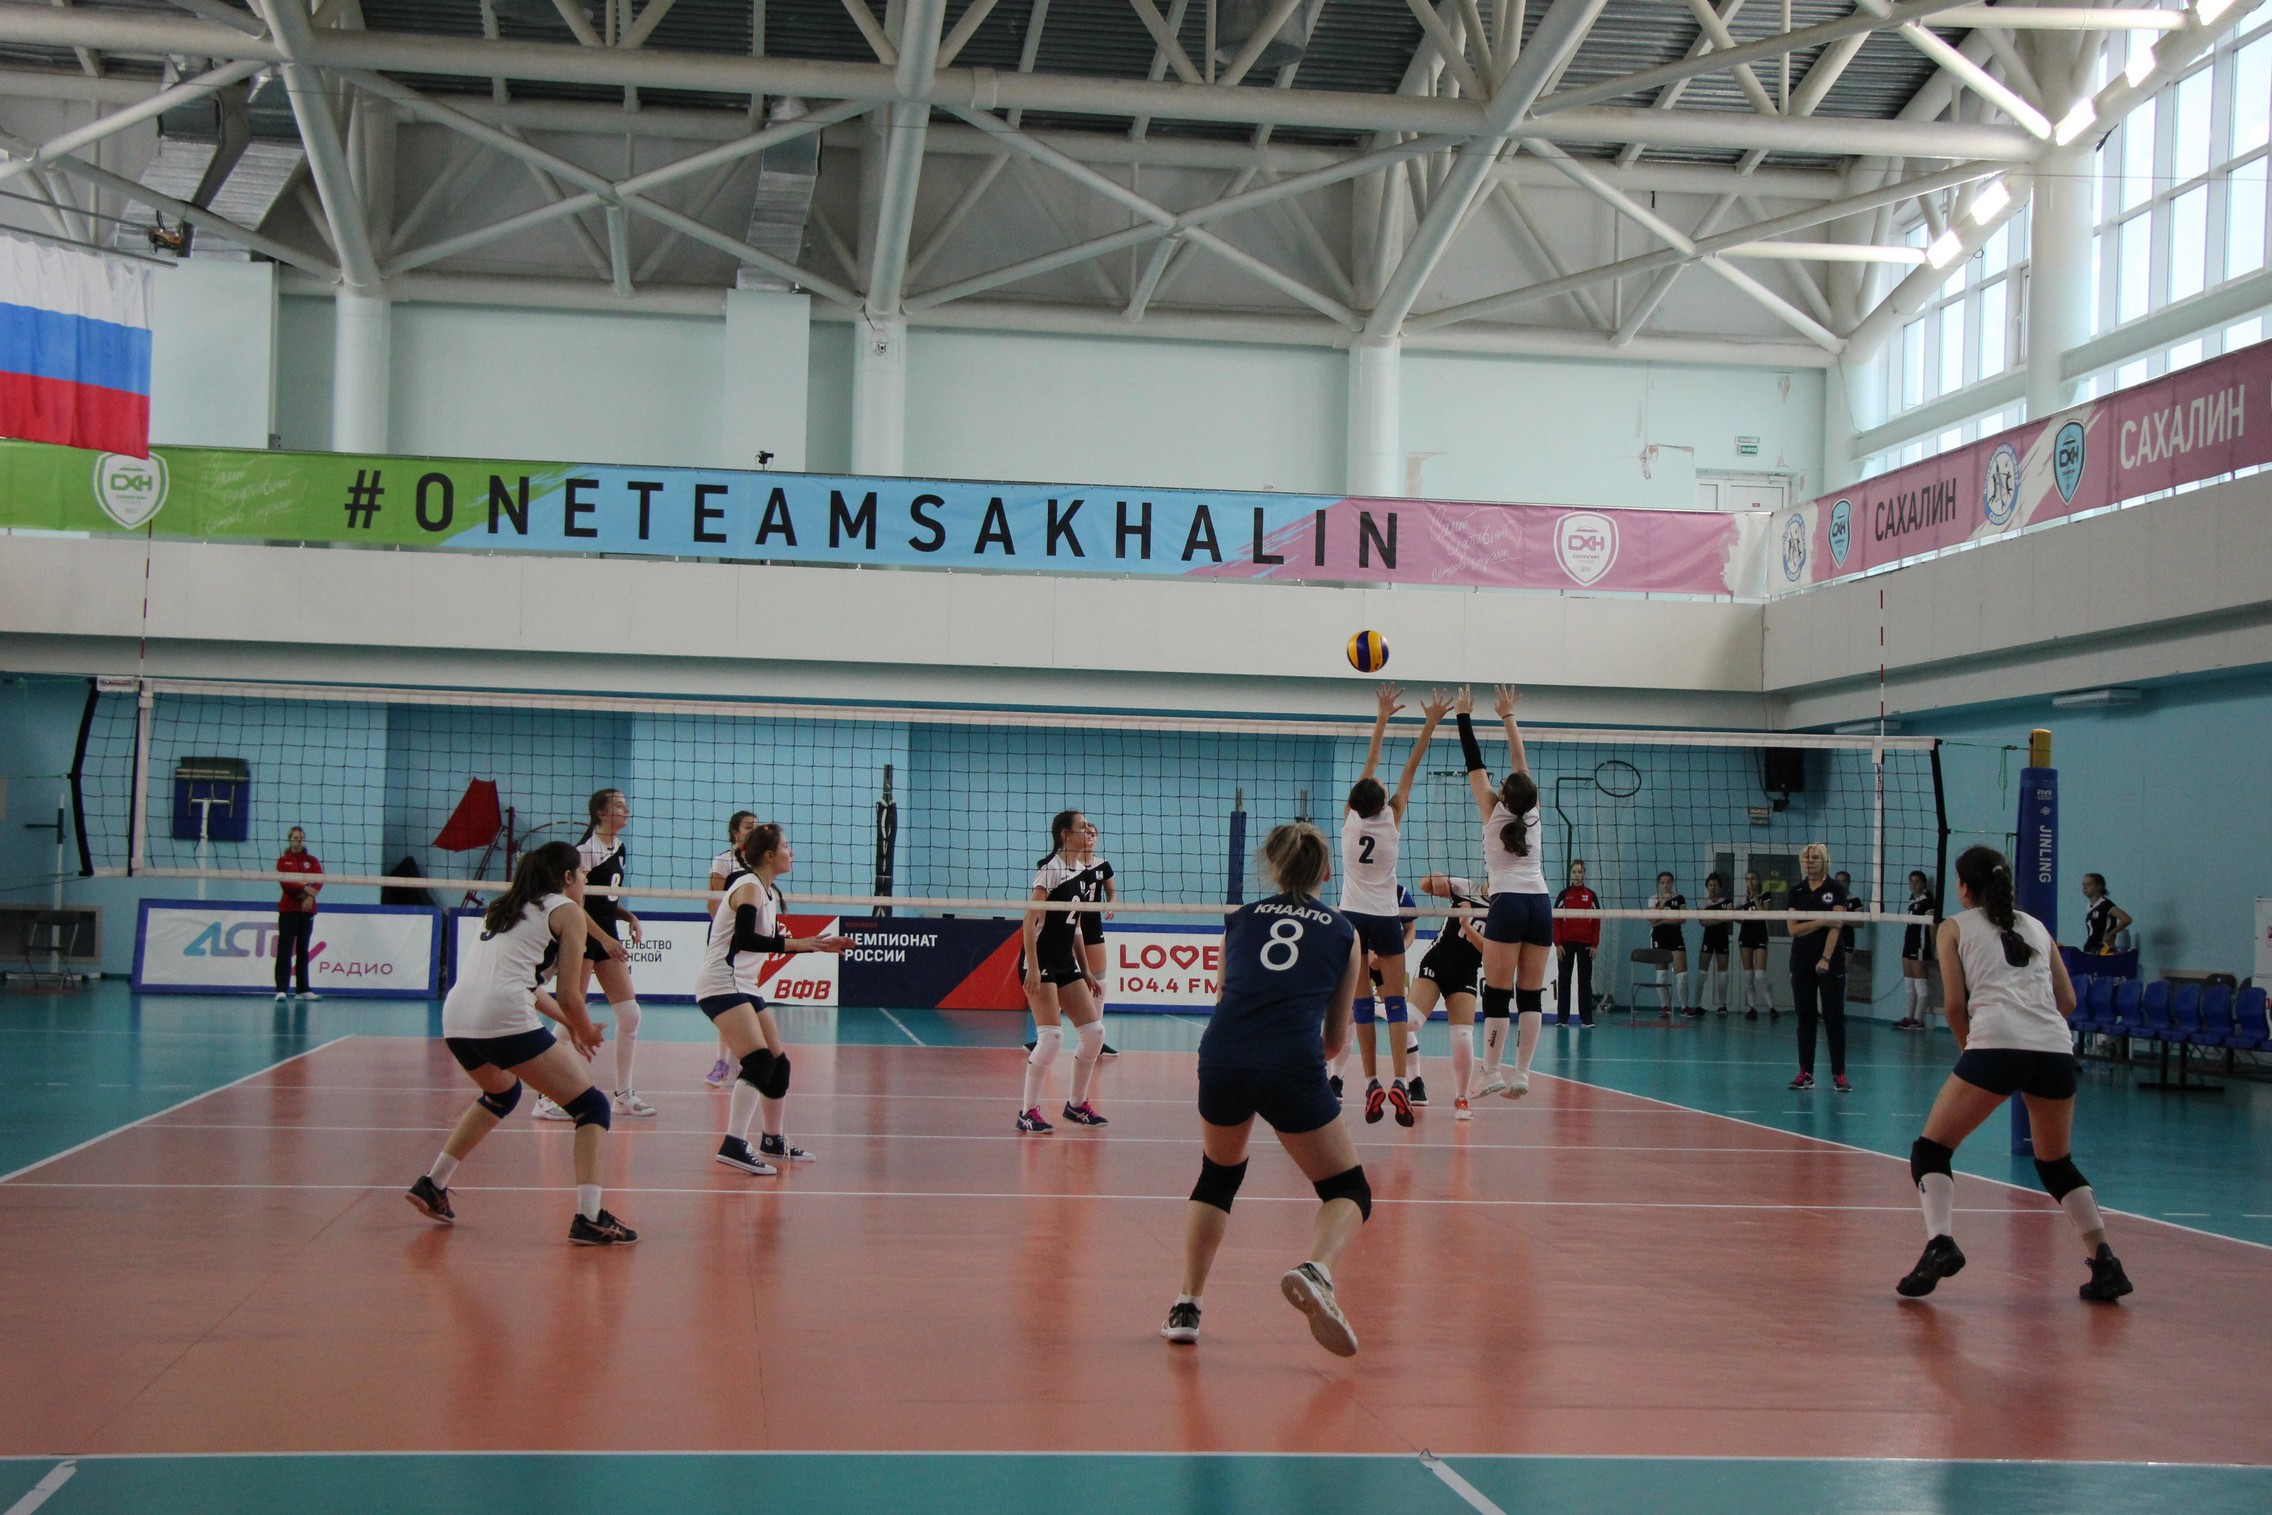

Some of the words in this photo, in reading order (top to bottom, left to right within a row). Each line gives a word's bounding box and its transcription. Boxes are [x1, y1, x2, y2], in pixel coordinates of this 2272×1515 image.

[2120, 384, 2245, 470] САХАЛИН
[344, 469, 1398, 570] #ONETEAMSAKHALIN
[1874, 478, 1957, 541] САХАЛИН
[1358, 836, 1376, 864] 2
[2039, 825, 2053, 883] JINLING
[1253, 903, 1333, 925] КНААПО
[844, 933, 938, 947] ЧЕМПИОНАТ
[1259, 918, 1304, 971] 8
[844, 949, 906, 962] РОССИИ
[319, 962, 394, 977] РАДИО
[774, 979, 832, 1000] ВФВ
[1120, 977, 1179, 993] 104.4
